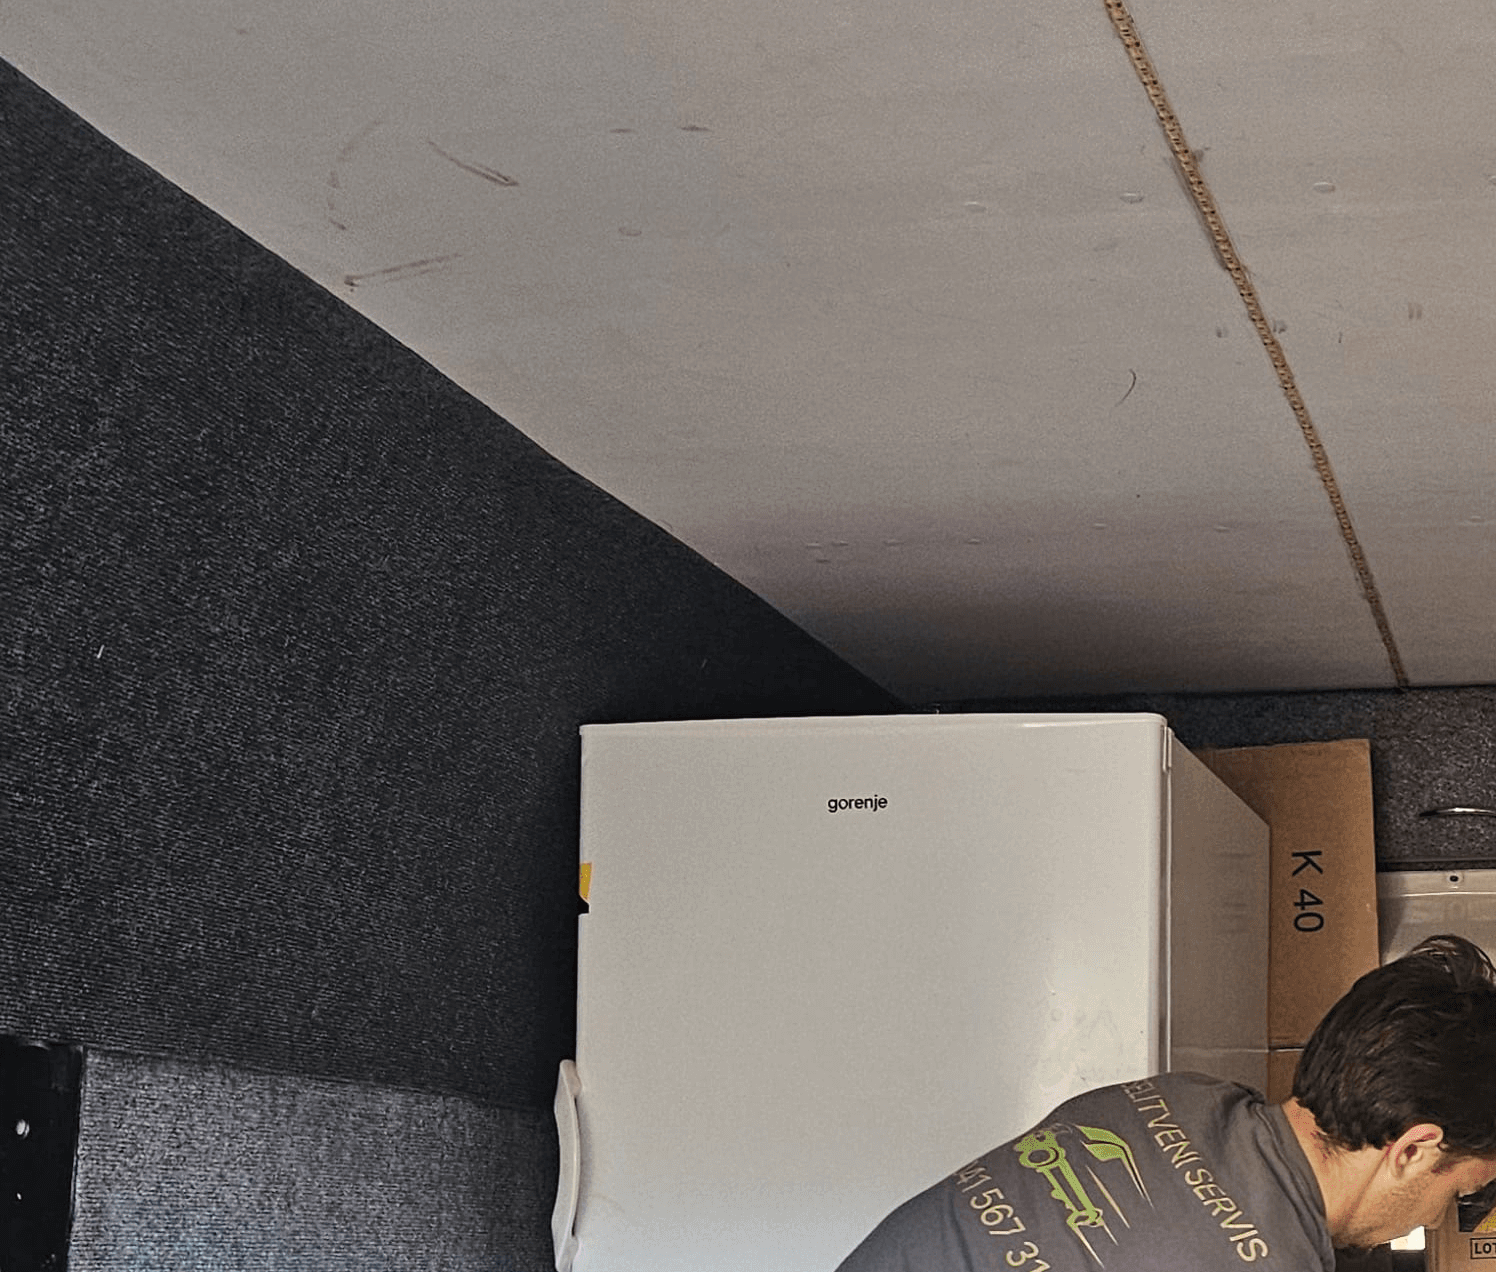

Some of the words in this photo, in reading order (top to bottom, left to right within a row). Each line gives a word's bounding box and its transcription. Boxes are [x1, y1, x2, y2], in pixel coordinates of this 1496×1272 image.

[827, 794, 889, 814] gorenje
[1291, 850, 1324, 877] K
[1293, 888, 1325, 933] 40
[953, 1160, 993, 1193] 41
[1120, 1080, 1203, 1170] ELITVENI
[1184, 1167, 1269, 1263] SERVIS
[969, 1187, 1027, 1236] 567
